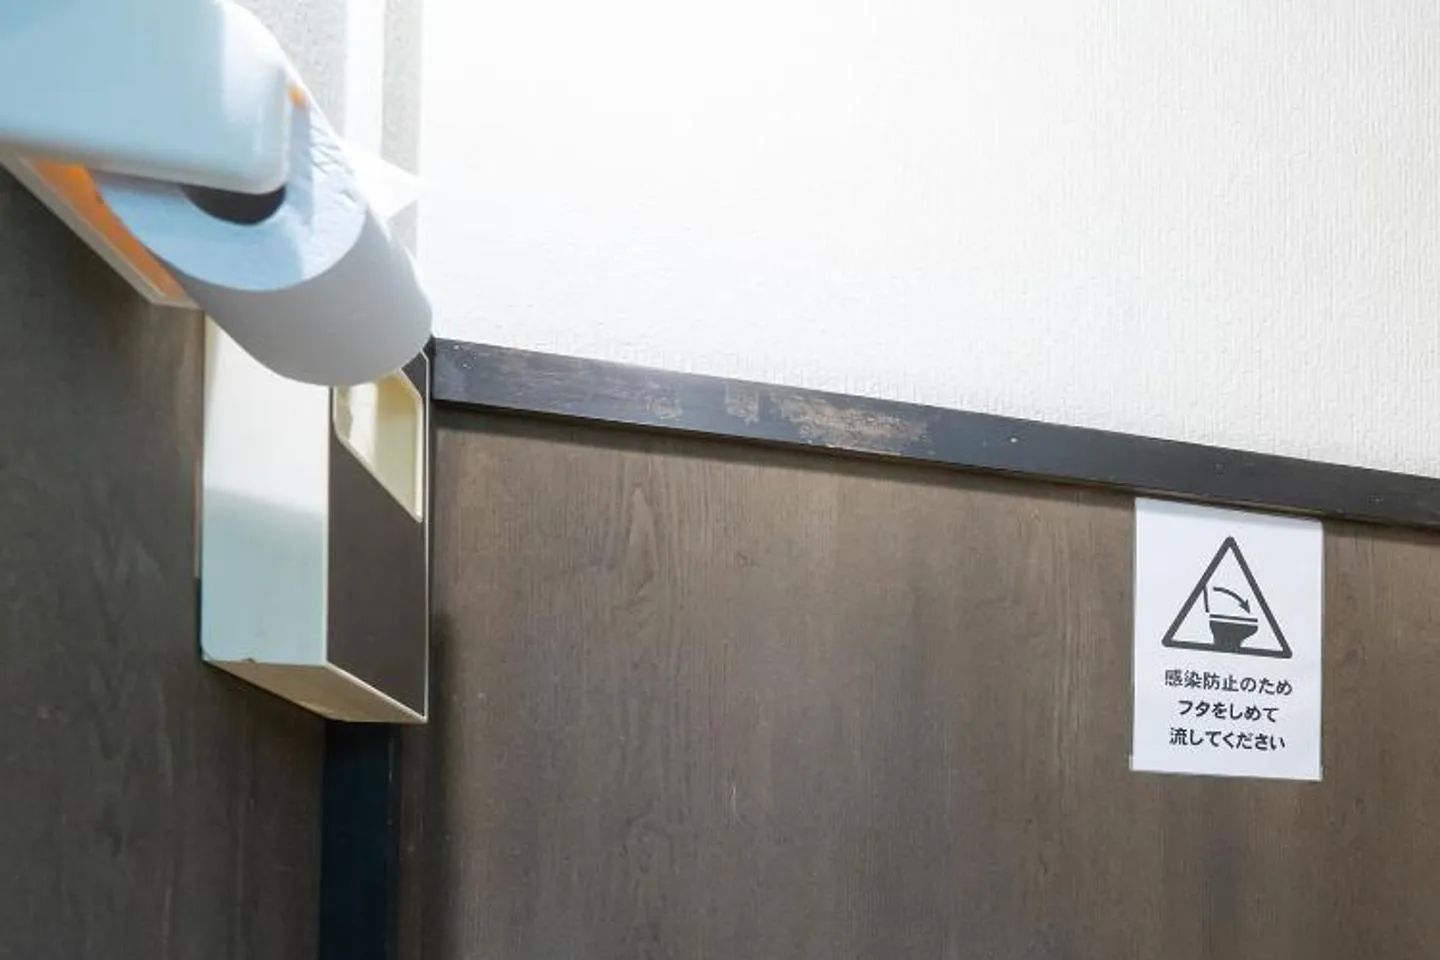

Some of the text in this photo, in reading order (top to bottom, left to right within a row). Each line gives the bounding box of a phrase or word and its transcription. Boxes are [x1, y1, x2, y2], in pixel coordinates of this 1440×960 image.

[1165, 669, 1293, 696] 感染防止のため
[1178, 699, 1280, 723] フタをしめて
[1169, 727, 1286, 751] 流してください
